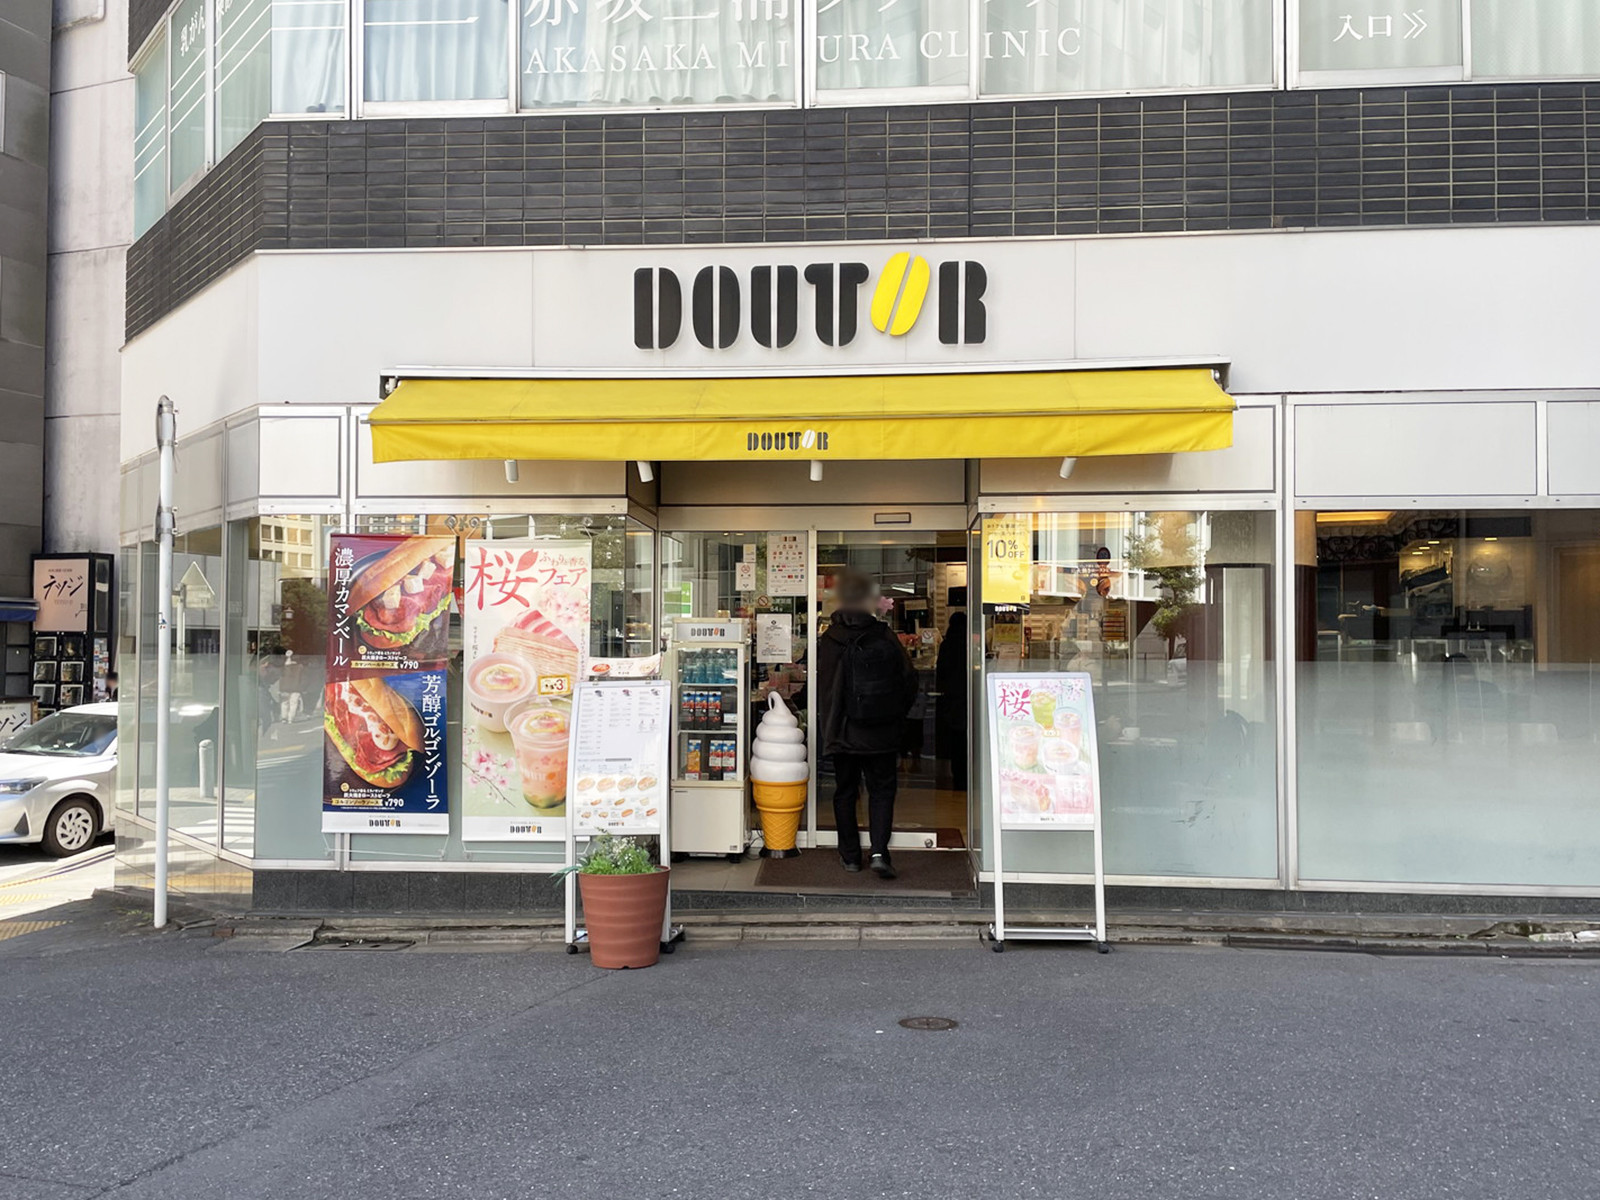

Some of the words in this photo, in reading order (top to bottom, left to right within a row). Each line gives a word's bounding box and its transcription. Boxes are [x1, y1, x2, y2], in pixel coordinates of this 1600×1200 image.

[1332, 15, 1393, 42] 入口
[524, 43, 716, 74] AKASAKA
[736, 35, 901, 68] MIURA
[920, 27, 1081, 59] CLINIC
[634, 252, 988, 350] DOUTOR
[747, 429, 829, 451] DOUTOR
[1008, 551, 1025, 559] OFF
[539, 568, 588, 587] フェア
[333, 547, 354, 667] 濃厚カマンベール
[691, 627, 725, 637] DOUTOR
[422, 674, 442, 811] 芳醇ゴルゴンゾーラ
